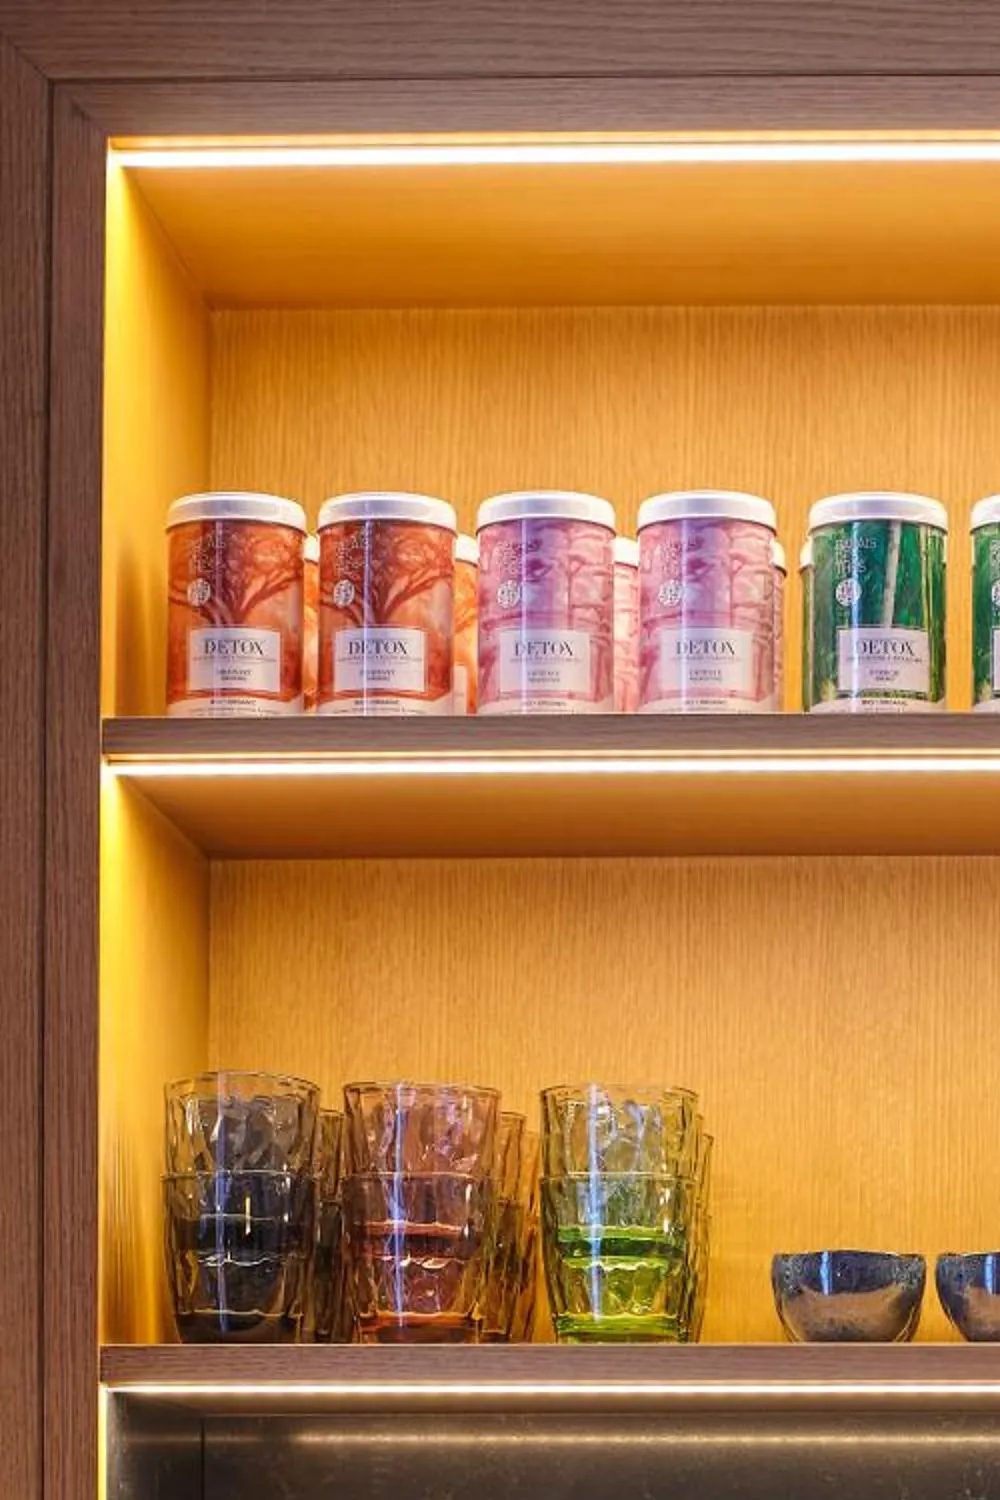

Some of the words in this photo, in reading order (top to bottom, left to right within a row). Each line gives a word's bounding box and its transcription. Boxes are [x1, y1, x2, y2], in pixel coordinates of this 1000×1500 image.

[204, 640, 265, 654] DETOX
[349, 640, 408, 654] DETOX
[676, 640, 736, 655] DETOX
